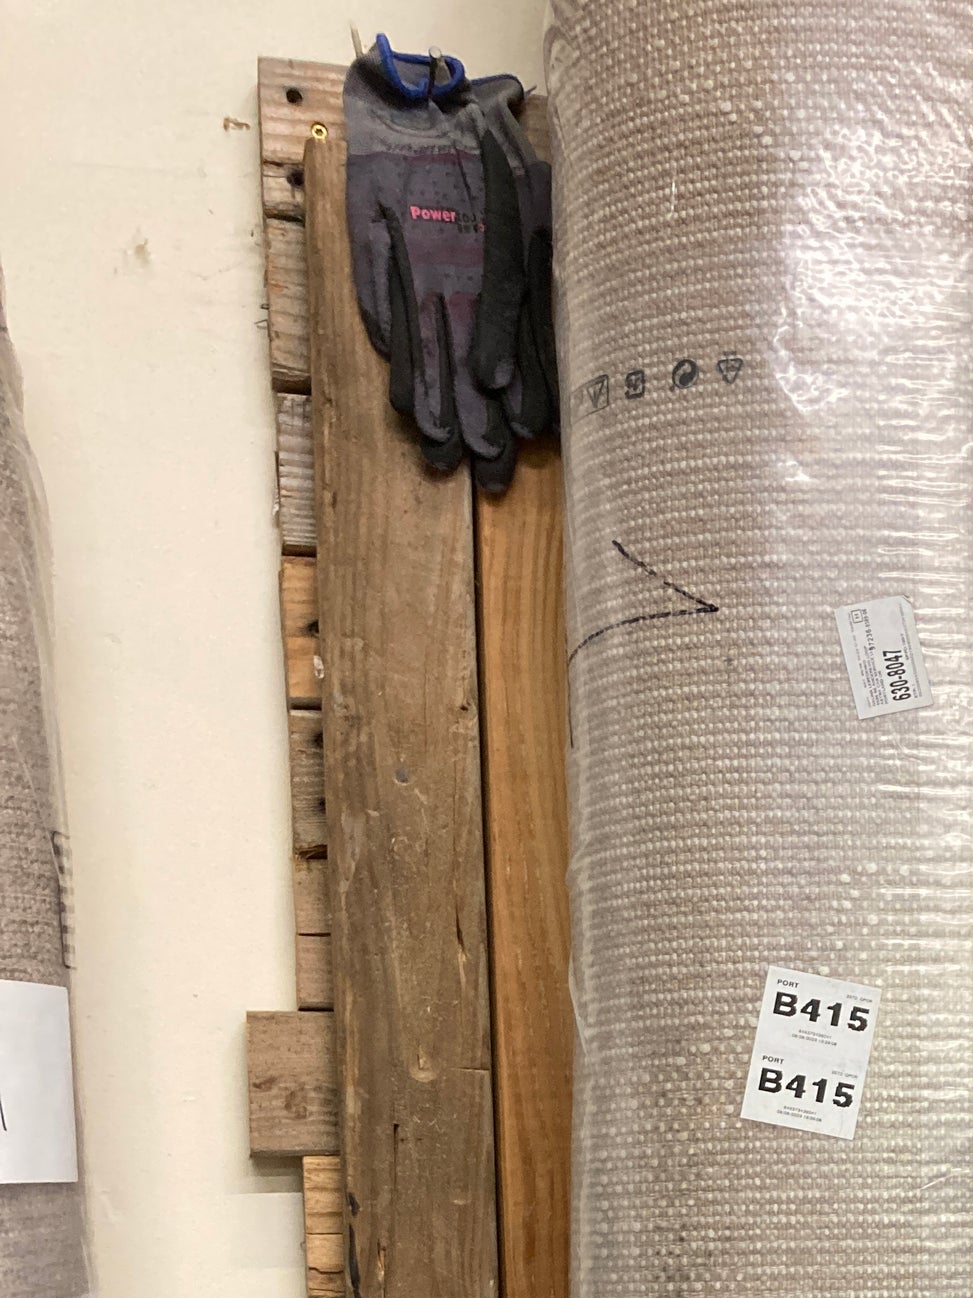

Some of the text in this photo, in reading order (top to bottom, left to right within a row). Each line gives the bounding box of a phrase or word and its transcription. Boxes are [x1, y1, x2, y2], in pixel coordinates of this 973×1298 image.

[882, 649, 912, 701] 630-8047
[777, 979, 799, 988] PORT
[772, 991, 870, 1032] B415
[762, 1055, 784, 1064] PORT
[758, 1067, 855, 1108] B415
